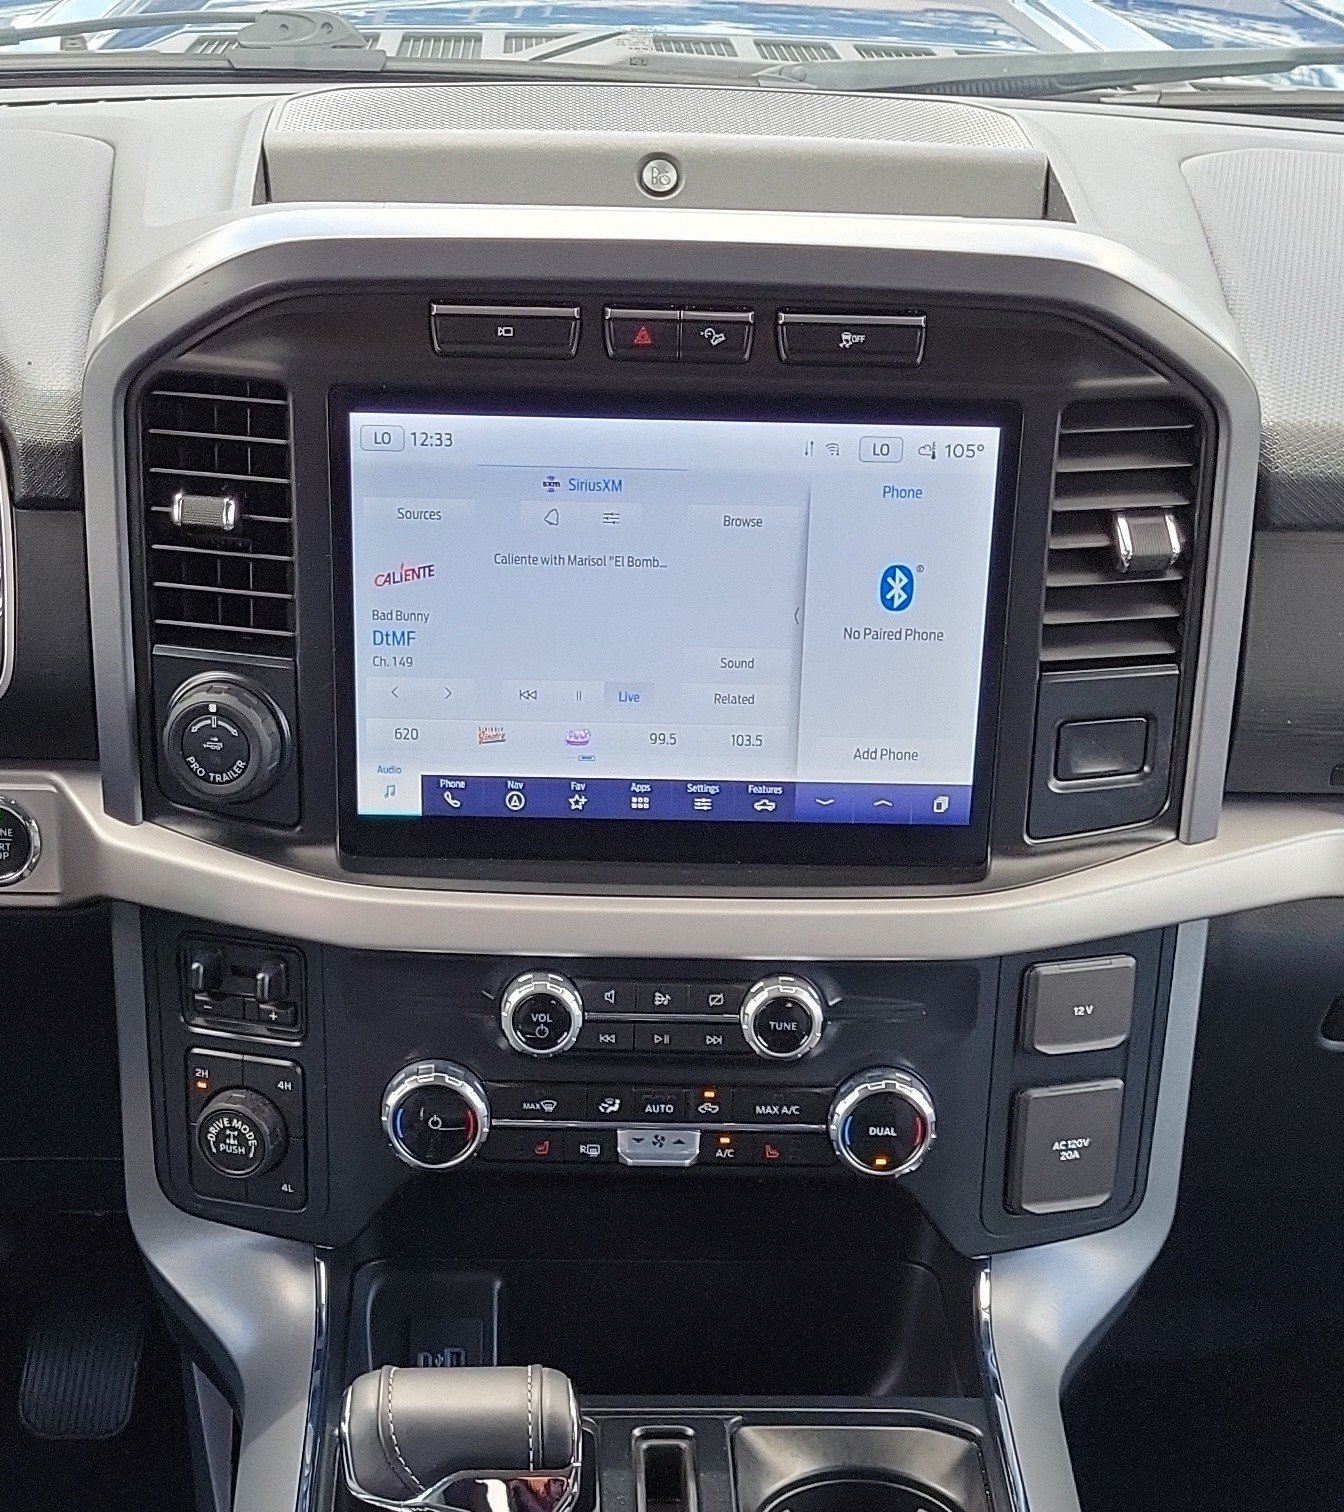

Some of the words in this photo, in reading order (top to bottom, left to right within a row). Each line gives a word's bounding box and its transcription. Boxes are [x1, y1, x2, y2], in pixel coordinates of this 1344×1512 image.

[373, 431, 392, 446] LO
[410, 431, 453, 447] 12:33
[872, 443, 890, 457] LO
[568, 477, 623, 492] SiriusXM
[882, 485, 924, 500] Phone
[397, 507, 442, 521] Sources
[723, 515, 763, 529] Browse
[493, 553, 539, 566] Caliente
[541, 554, 565, 567] with
[567, 554, 606, 567] Marisol
[372, 609, 393, 622] Bad
[395, 610, 430, 624] Bunny
[372, 630, 416, 647] DtMF
[843, 628, 861, 642] No
[863, 628, 902, 642] Paired
[904, 629, 944, 643] Phone
[373, 656, 390, 668] Ch.
[392, 656, 413, 668] 149
[720, 657, 754, 670] Sound
[618, 691, 640, 704] Live
[714, 693, 755, 706] Related
[394, 727, 419, 741] 620
[649, 732, 677, 746] 99.5
[731, 734, 763, 747] 103.5
[853, 747, 878, 762] Add
[880, 748, 919, 763] Phone
[186, 756, 206, 776] PRO
[209, 759, 247, 783] TRAILER
[377, 764, 402, 775] Audio
[439, 778, 466, 790] Phone
[507, 780, 524, 790] Nav
[570, 781, 586, 792] Fav
[631, 783, 651, 794] Apps
[687, 783, 720, 795] Settings
[748, 784, 783, 795] Features
[531, 1014, 553, 1022] VOL
[769, 1021, 798, 1031] TUNE
[195, 1068, 209, 1078] 2H
[277, 1081, 292, 1091] 4H
[522, 1102, 540, 1110] MAX
[645, 1104, 674, 1113] AUTO
[756, 1105, 779, 1115] MAX
[781, 1105, 800, 1115] A/C
[207, 1118, 231, 1141] DRIVE
[232, 1119, 257, 1146] MODE
[869, 1127, 897, 1136] DUAL
[219, 1143, 245, 1154] PUSH
[716, 1148, 734, 1158] A/C
[1059, 1150, 1080, 1161] 20A
[281, 1183, 294, 1193] 4L
